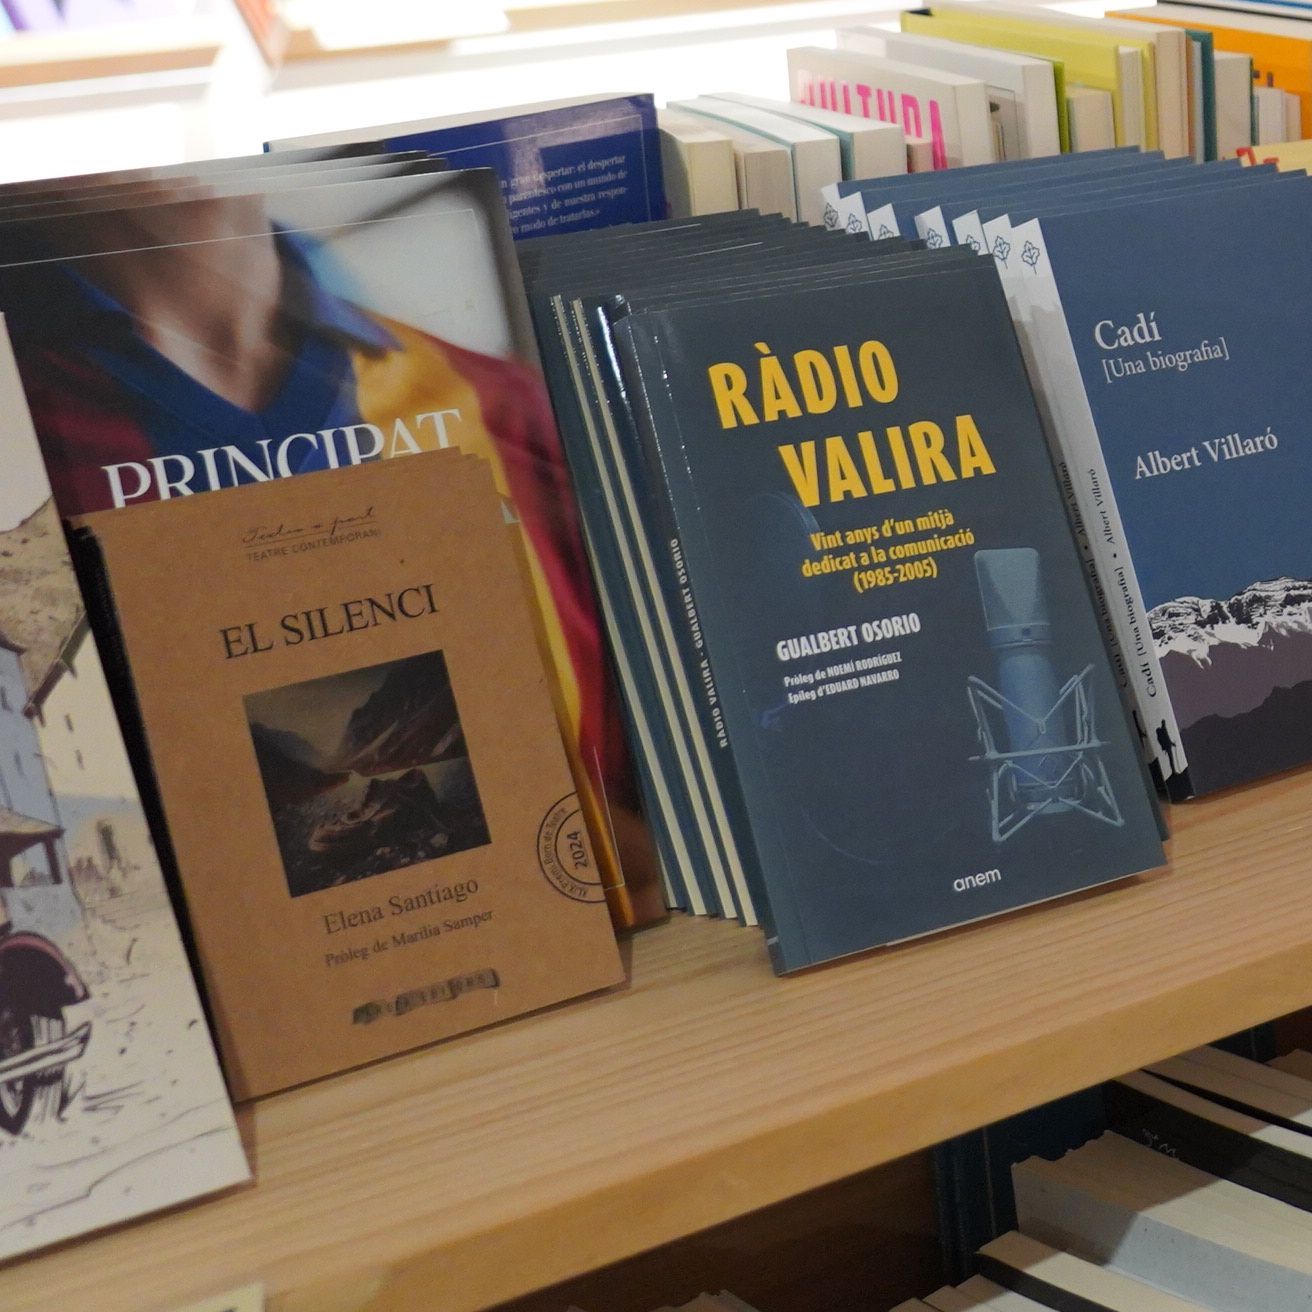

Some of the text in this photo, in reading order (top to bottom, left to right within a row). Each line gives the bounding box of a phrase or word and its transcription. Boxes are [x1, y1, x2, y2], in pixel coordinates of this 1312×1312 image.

[1094, 311, 1163, 350] Cadí
[1102, 337, 1230, 384] [Una biografia]
[708, 340, 898, 429] RÀDIO
[102, 408, 463, 509] PRINCIPAT
[778, 414, 997, 508] VALIRA
[1134, 426, 1279, 480] Albert Villaró
[1087, 467, 1105, 507] Villaró
[810, 509, 954, 552] Vint anys d'un mitjà
[1100, 509, 1116, 544] Albert
[248, 546, 289, 562] TEATRE
[670, 537, 688, 585] OSORIO
[801, 527, 975, 578] dedicat a la comunicació
[853, 557, 938, 594] (1985-2005)
[681, 587, 704, 649] GUALBERT
[1114, 567, 1136, 625] biografia]
[219, 583, 440, 660] EL SILENCI
[776, 612, 921, 661] GUALBERT OSORIO
[700, 658, 717, 706] VALIRA
[784, 651, 903, 687] Pròleg de NOEMÍ RODRÍGUEZ
[860, 668, 900, 687] NAVARRO
[1140, 661, 1158, 698] Cadí
[566, 830, 590, 870] 2024
[953, 867, 1002, 892] anem
[324, 879, 479, 934] Elena Santiago
[373, 939, 388, 952] de
[443, 910, 494, 933] Samper
